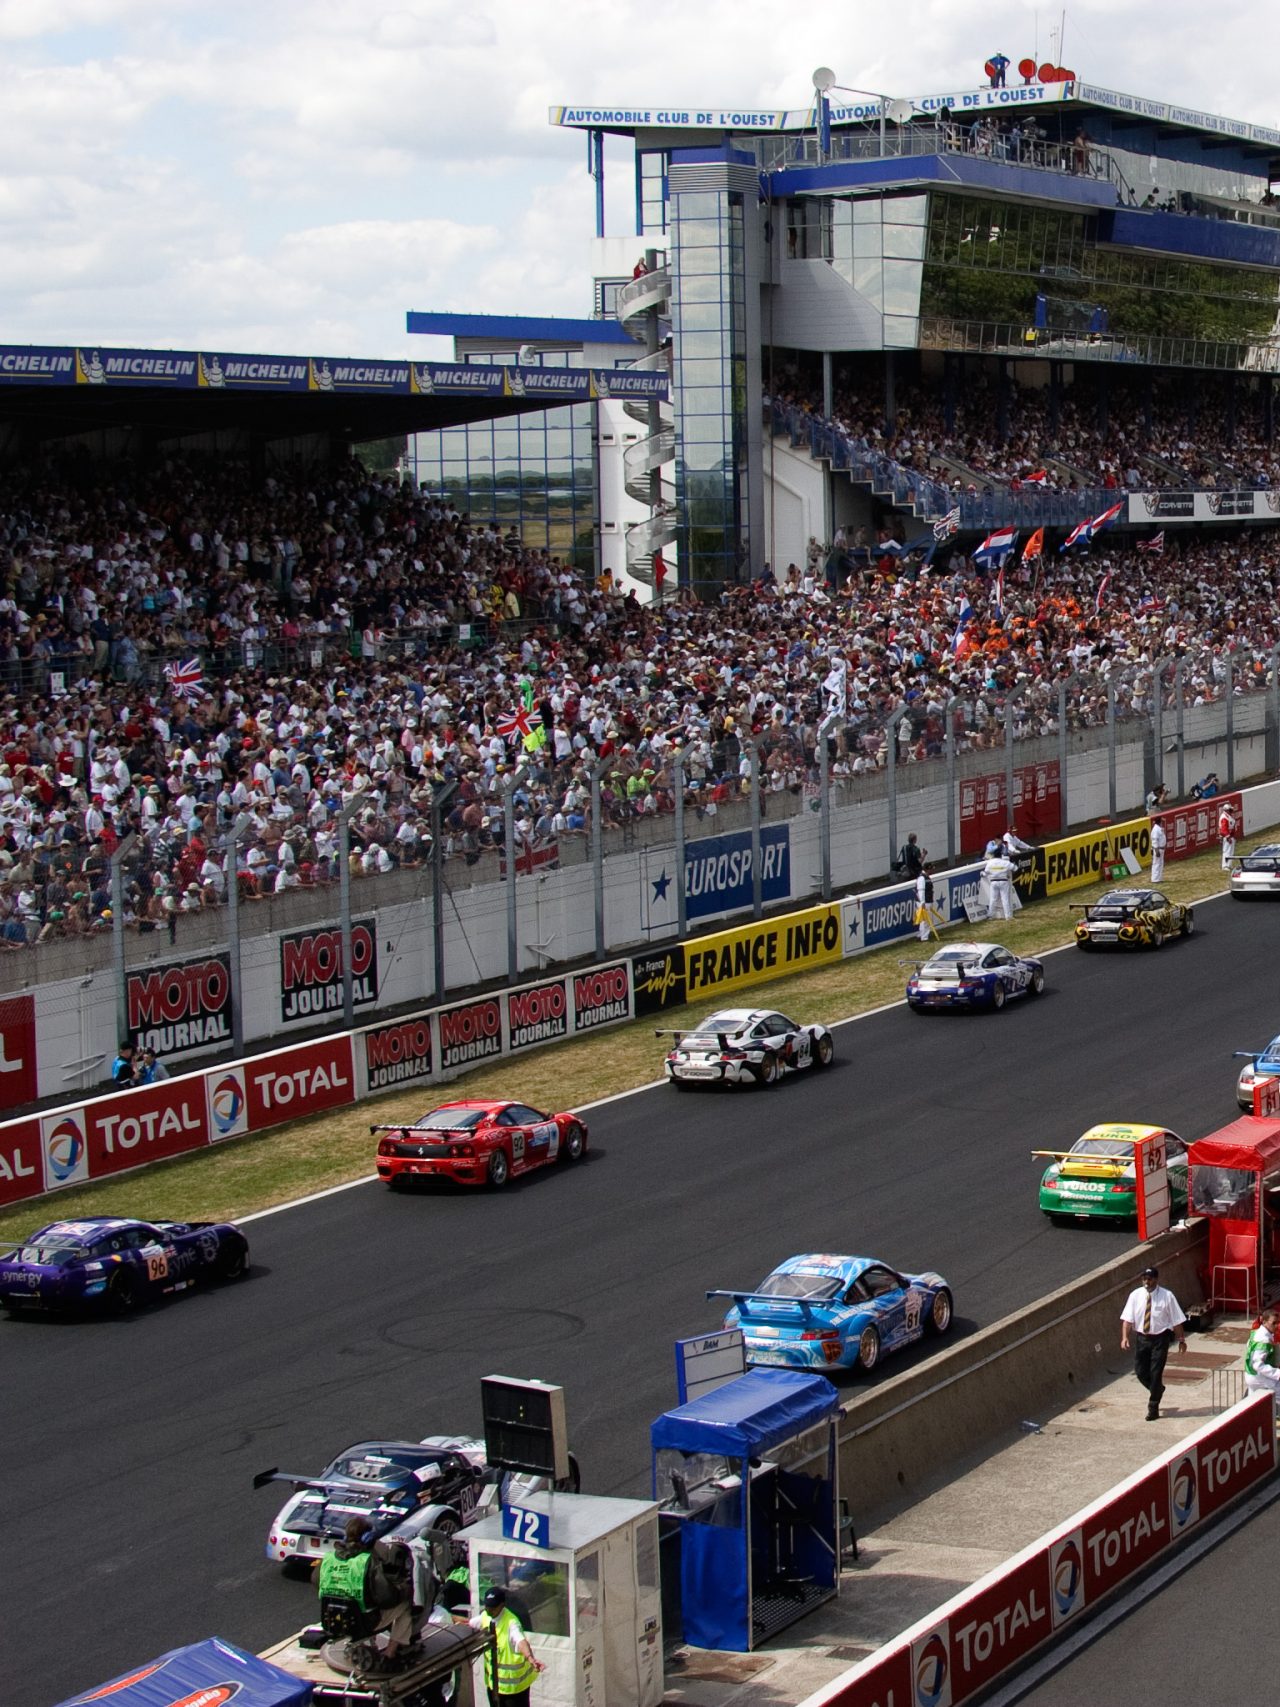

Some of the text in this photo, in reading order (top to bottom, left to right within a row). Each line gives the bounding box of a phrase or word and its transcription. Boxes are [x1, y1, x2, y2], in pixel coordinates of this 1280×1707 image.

[922, 96, 955, 111] CLUB
[963, 94, 980, 106] DE
[987, 87, 1044, 103] L'OUEST
[1083, 87, 1117, 106] AUTOMOBILE
[1120, 97, 1132, 109] CLUB
[1135, 101, 1141, 112] DE
[567, 110, 775, 126] AUTOMOBILE CLUB DE L'OUEST
[1172, 109, 1203, 125] AUTOMOBILE
[106, 358, 195, 375] MICHELIN
[225, 362, 306, 379] MICHELIN
[334, 367, 408, 382] MICHELIN
[434, 371, 502, 385] MICHELIN
[525, 374, 588, 388] MICHELIN
[610, 377, 669, 391] MICHELIN
[685, 842, 787, 898] EUROSPRT
[645, 959, 665, 973] France
[689, 915, 839, 991] FRANCE INFO
[574, 967, 629, 1012] MOTO
[636, 954, 684, 1005] info
[127, 960, 229, 1030] MOTO
[509, 982, 567, 1030] MOTO
[440, 1001, 501, 1050] MOTO
[577, 999, 628, 1030] JOURNAL
[366, 1020, 431, 1070] MOTO
[511, 1018, 566, 1048] JOURNAL
[443, 1038, 500, 1071] JOURNAL
[255, 1061, 348, 1109] TOTAL
[370, 1058, 431, 1089] JOURNAL
[96, 1102, 200, 1154] TOTAL
[1092, 1132, 1140, 1141] YUKOS
[513, 1135, 524, 1152] 92
[1148, 1148, 1163, 1173] 62
[1063, 1181, 1107, 1192] YUKOS
[2, 1270, 42, 1288] synergy
[150, 1260, 167, 1278] 96
[906, 1311, 919, 1330] 81
[1201, 1426, 1270, 1493] TOTAL
[461, 1486, 474, 1513] 80
[509, 1507, 540, 1546] 72
[1087, 1501, 1165, 1577] TOTAL
[955, 1589, 1046, 1672] TOTAL
